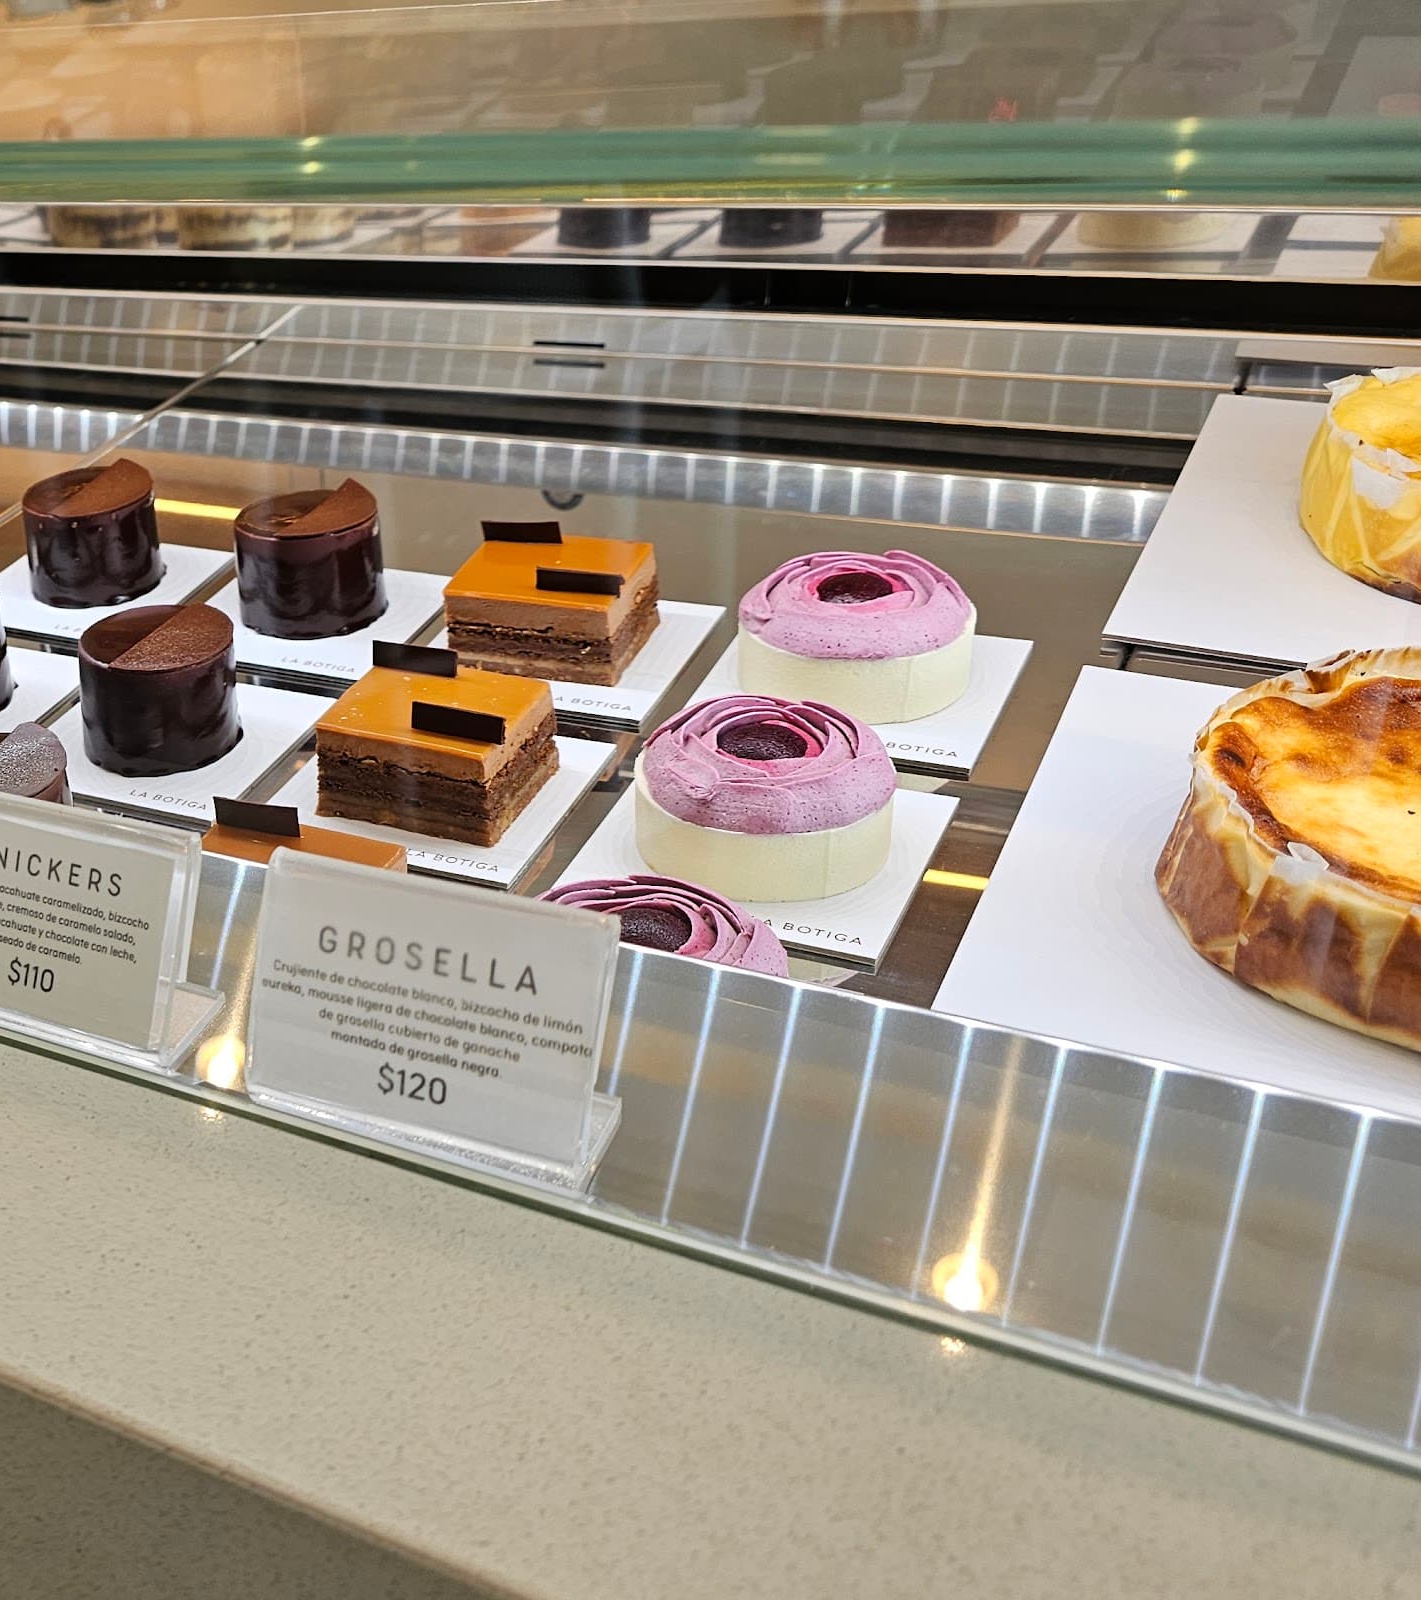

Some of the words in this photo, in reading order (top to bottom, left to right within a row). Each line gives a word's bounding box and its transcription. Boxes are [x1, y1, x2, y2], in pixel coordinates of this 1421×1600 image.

[303, 659, 355, 673] BOTIGA
[570, 697, 632, 711] BOTIGA
[885, 741, 958, 758] BOTIGA
[129, 788, 148, 798] LA
[153, 793, 207, 811] BOTIGA
[433, 853, 499, 873] BOTIGA
[6, 903, 44, 920] cremoso
[45, 911, 57, 924] de
[58, 916, 101, 936] caramelo
[102, 927, 136, 947] salado,
[42, 895, 106, 922] caramelizado,
[108, 909, 150, 931] bizcocho
[25, 939, 38, 952] de
[38, 945, 84, 965] caramelo.
[37, 929, 44, 940] y
[44, 931, 90, 950] chocolate
[90, 942, 108, 954] con
[109, 944, 137, 965] leche,
[782, 922, 862, 946] BOTIGA
[7, 956, 55, 993] $110
[317, 925, 538, 997] GROSELLA
[273, 958, 327, 981] Crujiente
[329, 971, 346, 985] de
[347, 976, 409, 999] chocolate
[411, 987, 458, 1011] blanco,
[461, 998, 520, 1023] bizcocho
[522, 1011, 540, 1027] de
[542, 1014, 584, 1036] limón
[261, 977, 305, 998] eureka,
[308, 987, 354, 1006] mousse
[355, 995, 394, 1014] ligera
[395, 1004, 412, 1019] de
[413, 1009, 477, 1033] chocolate
[479, 1021, 528, 1047] blanco,
[531, 1035, 594, 1060] compota
[318, 1007, 334, 1021] de
[336, 1013, 386, 1033] grosella
[388, 1023, 441, 1045] cubierto
[443, 1035, 460, 1049] de
[461, 1040, 522, 1063] ganache
[330, 1031, 387, 1052] montada
[388, 1041, 406, 1057] de
[406, 1047, 458, 1069] grosella
[377, 1060, 447, 1105] $120
